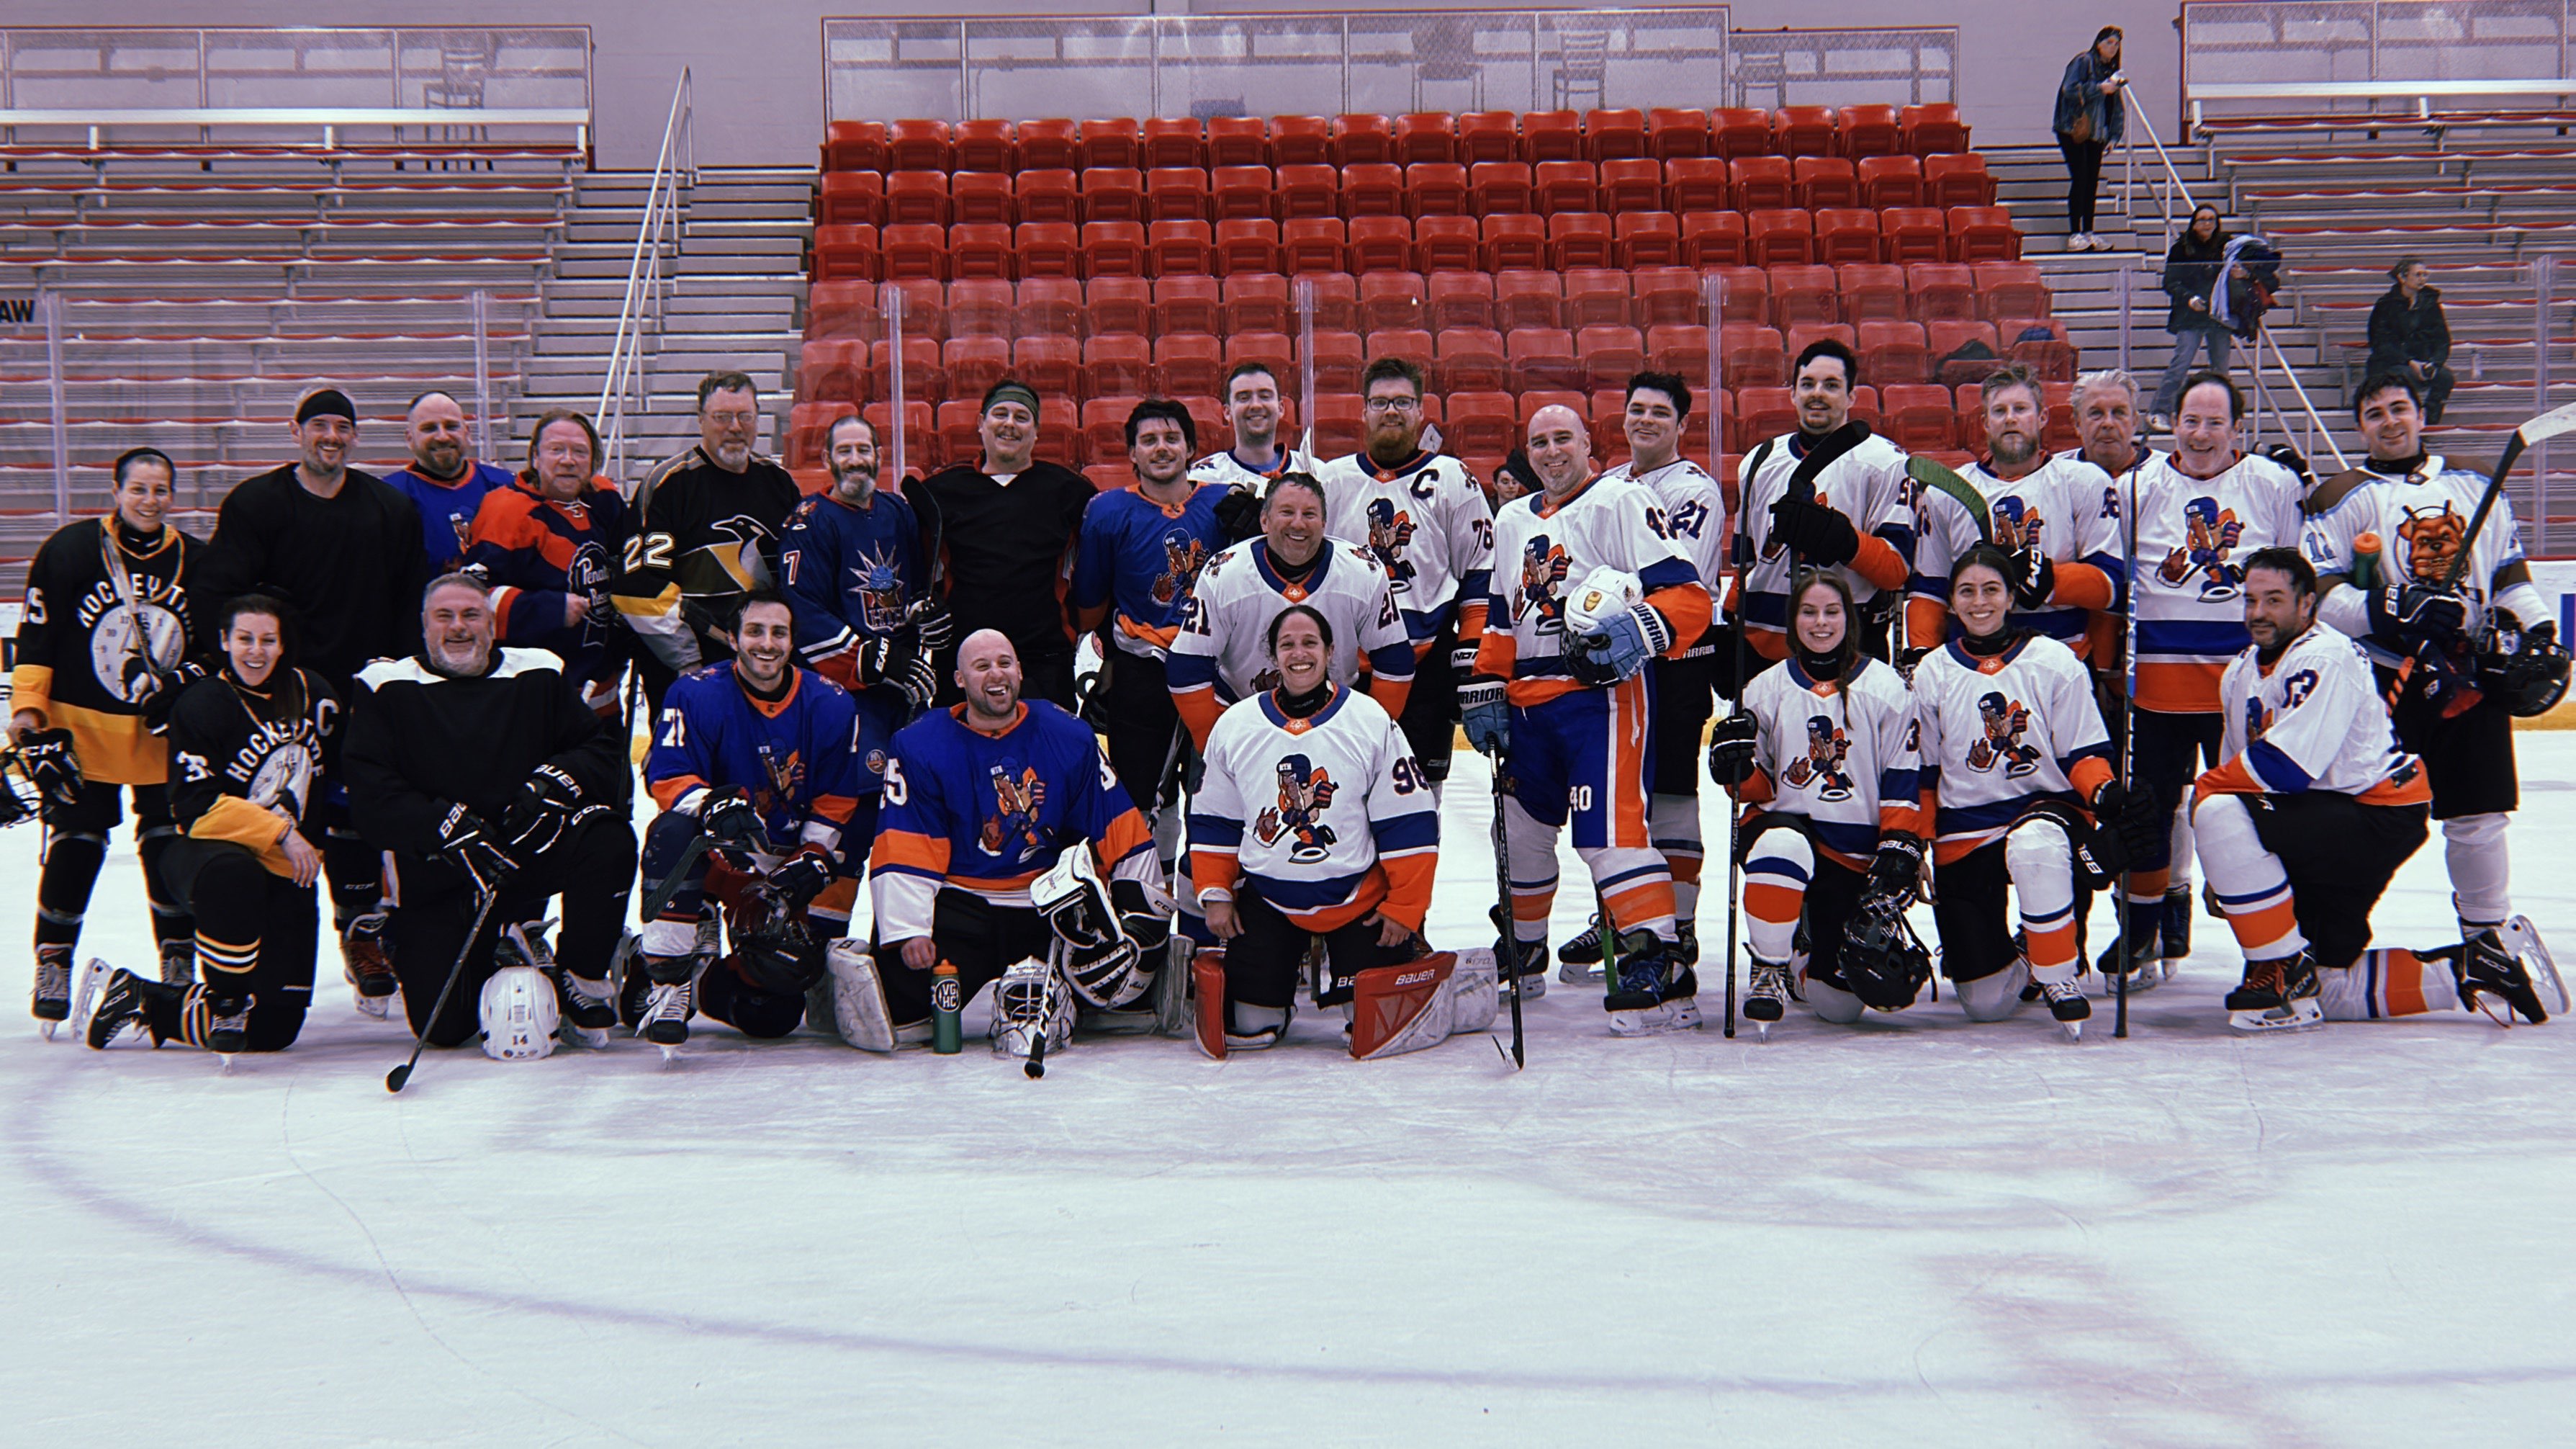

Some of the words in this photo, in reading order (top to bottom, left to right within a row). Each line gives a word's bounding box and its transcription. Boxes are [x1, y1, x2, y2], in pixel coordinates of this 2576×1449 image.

[1410, 469, 1439, 499] C
[1672, 500, 1709, 540] 21
[622, 531, 675, 574] 22
[1472, 519, 1494, 561] 76
[783, 549, 801, 586] 7
[76, 573, 161, 629] HOCEY
[1182, 596, 1211, 637] 21
[2126, 580, 2138, 676] NEXUS
[317, 699, 340, 737] C
[703, 797, 748, 824] CCM
[1570, 785, 1592, 812] 40
[942, 983, 956, 995] VG
[1395, 969, 1435, 986] BAUER
[942, 996, 956, 1008] HC
[513, 1034, 528, 1046] 14
